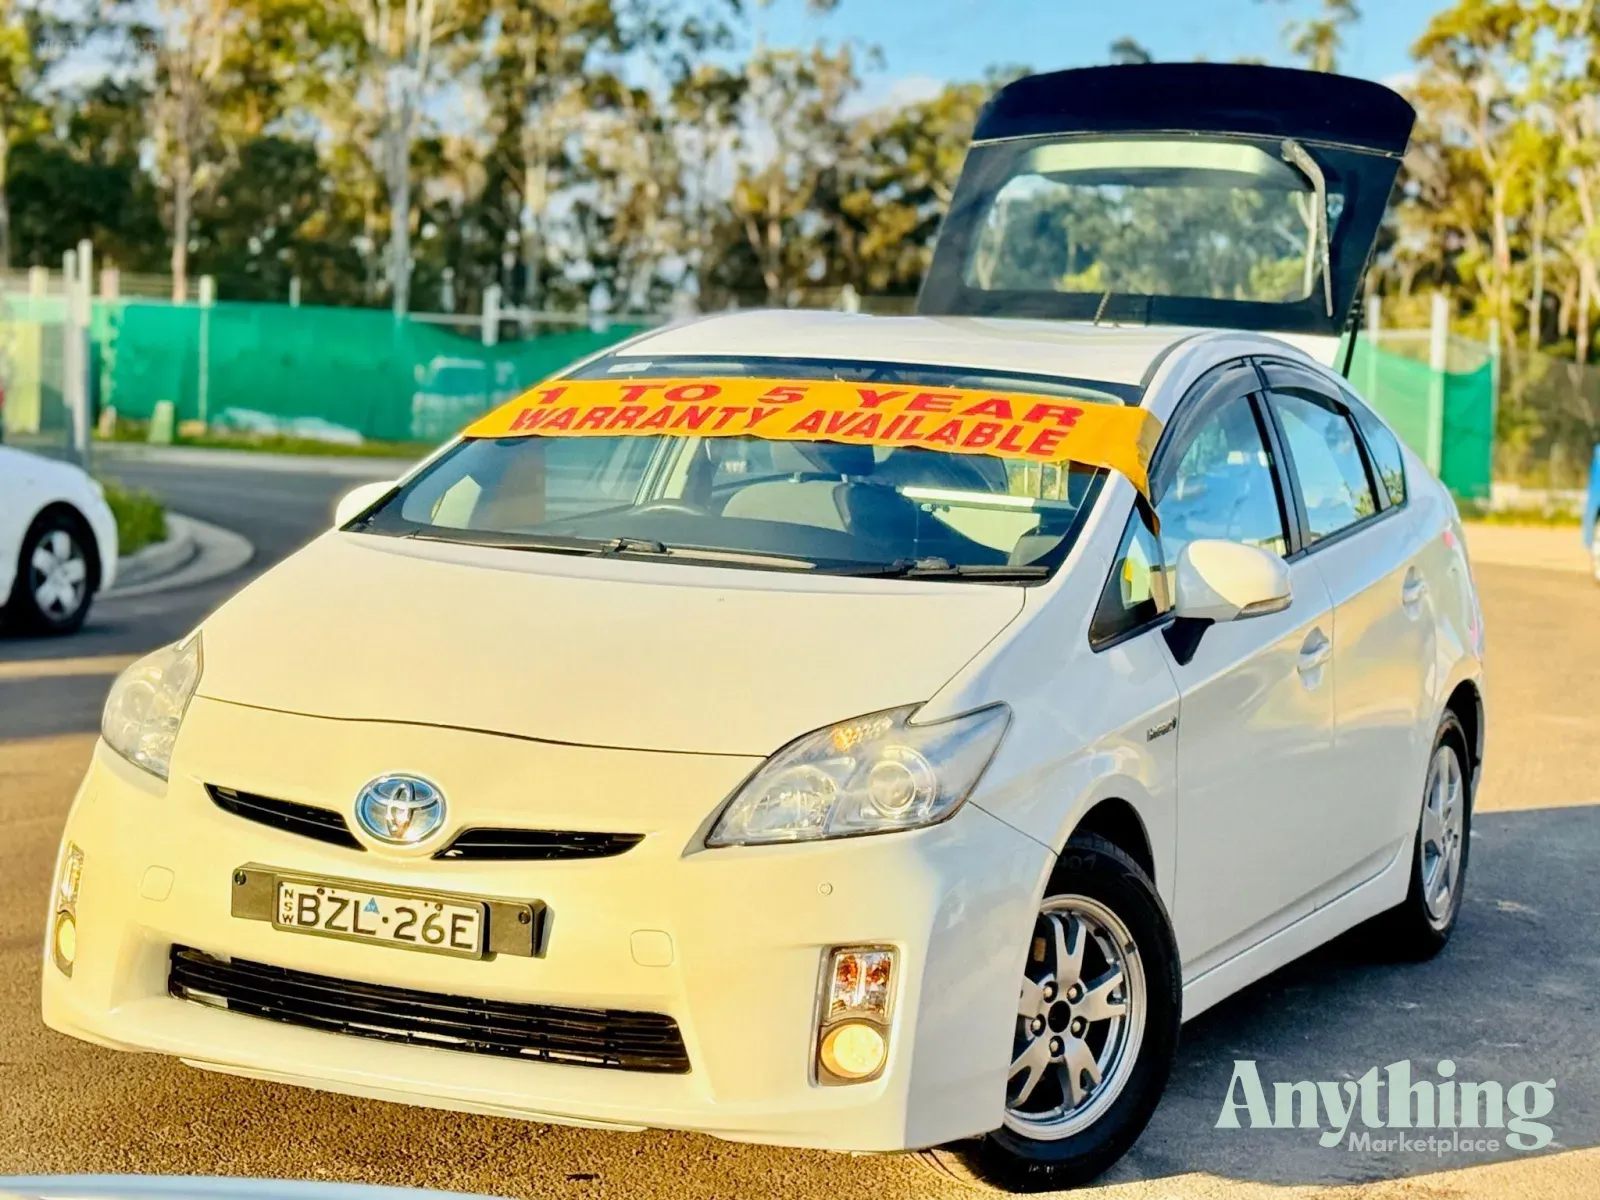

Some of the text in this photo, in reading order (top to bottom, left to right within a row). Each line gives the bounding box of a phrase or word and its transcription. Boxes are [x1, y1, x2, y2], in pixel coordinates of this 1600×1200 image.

[538, 384, 1085, 427] 1 TO 5 YEAR
[509, 406, 1068, 455] WARRANTY AVAILABLE
[283, 888, 295, 924] NSW
